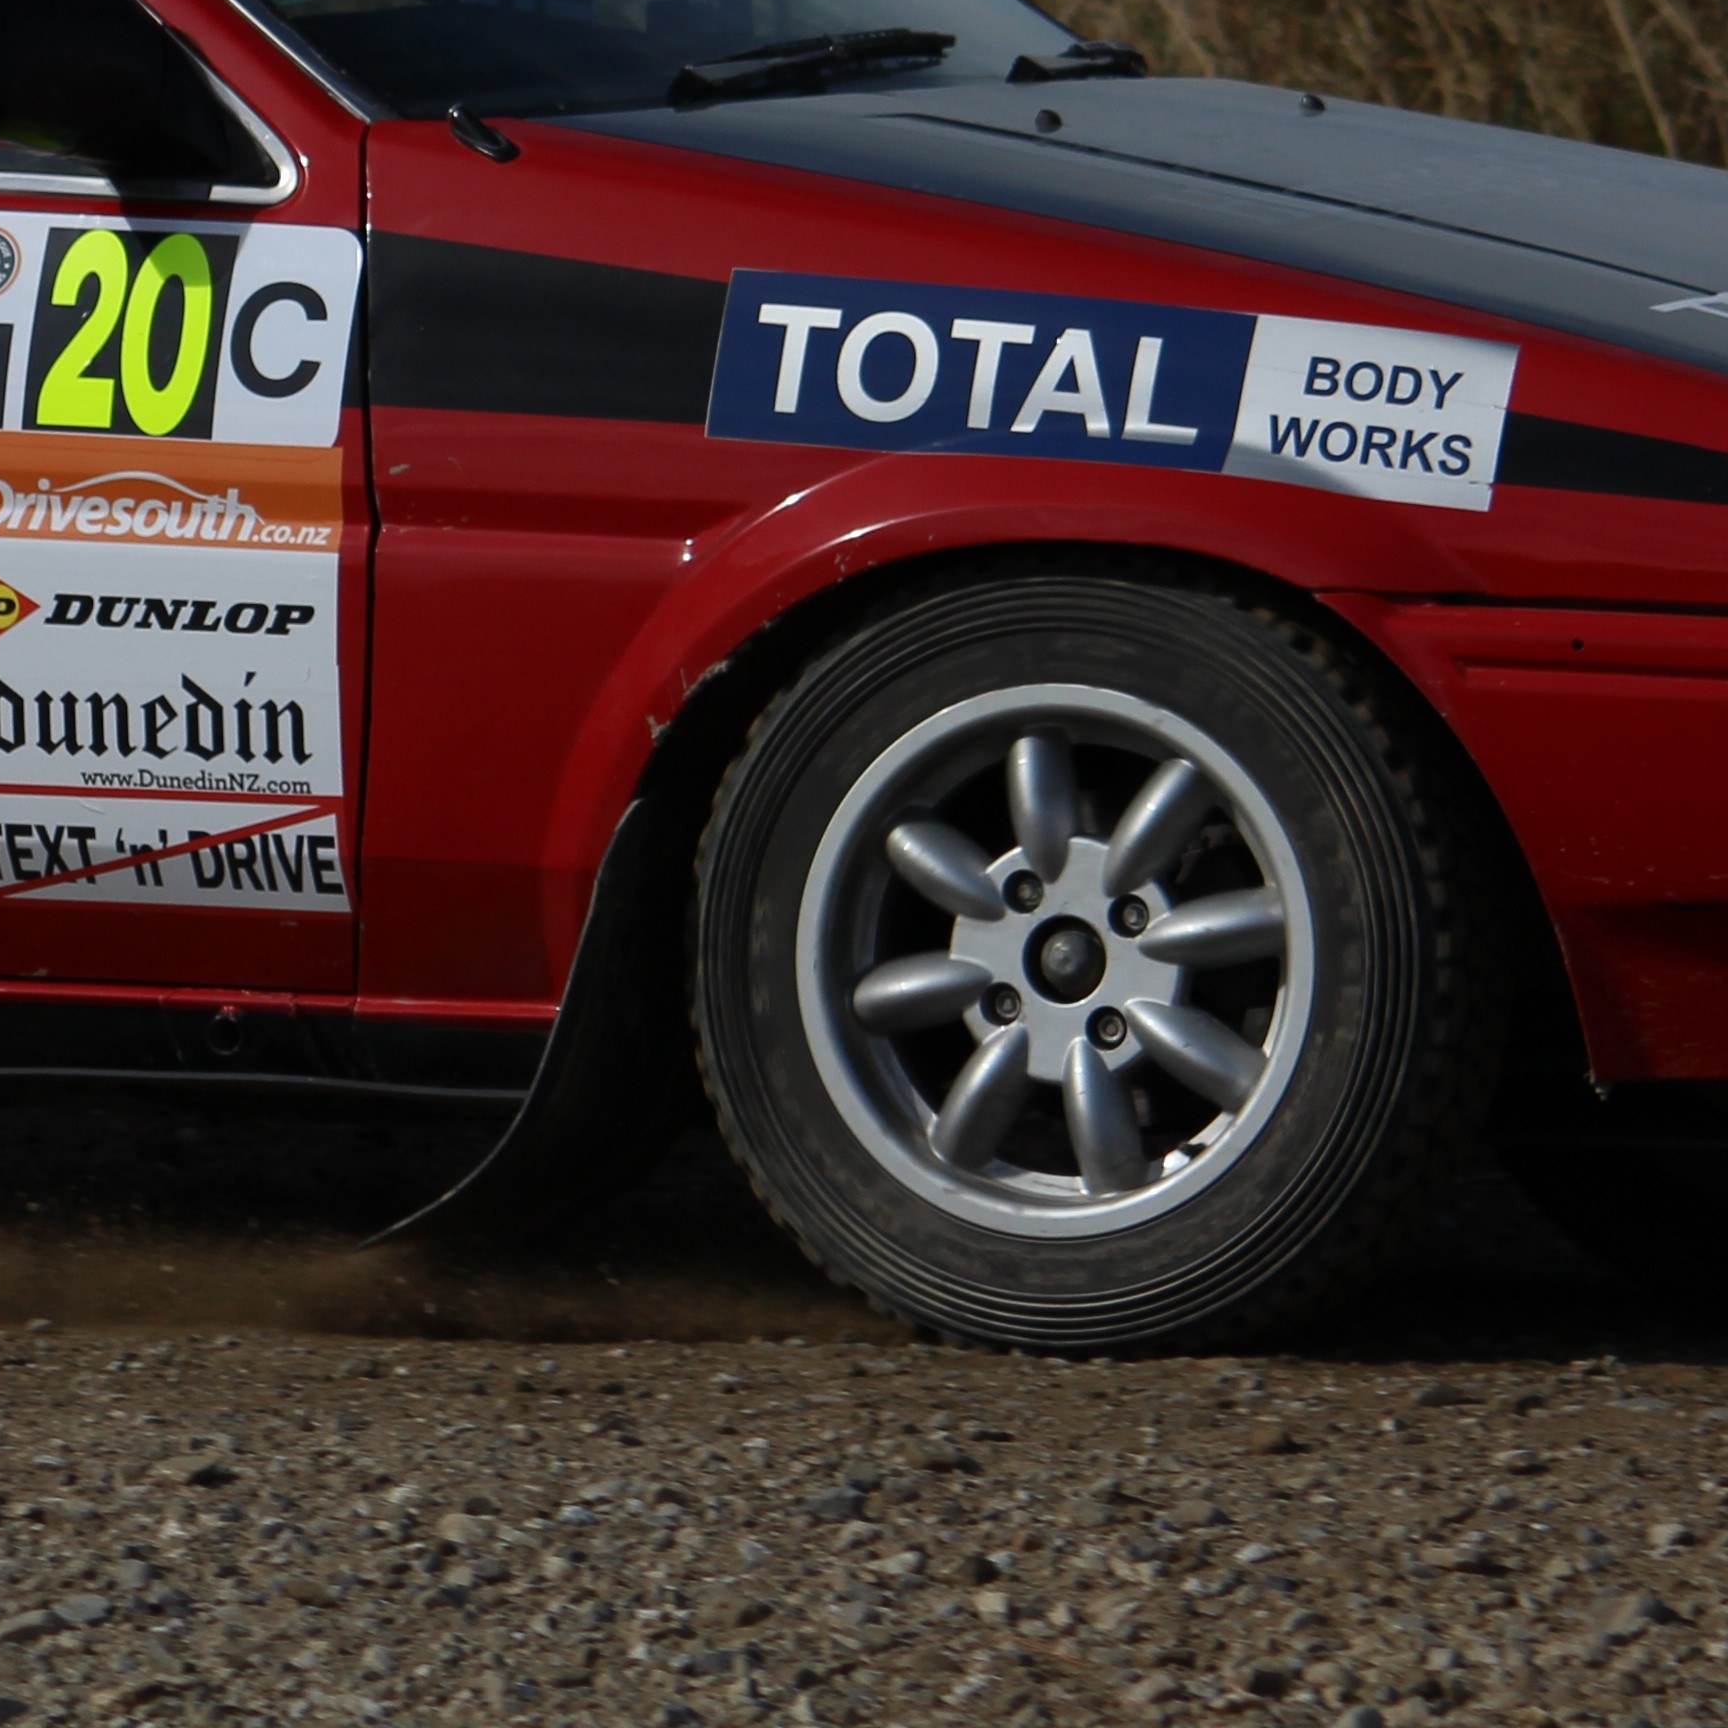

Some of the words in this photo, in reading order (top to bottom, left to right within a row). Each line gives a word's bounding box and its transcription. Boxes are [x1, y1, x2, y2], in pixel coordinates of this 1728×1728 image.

[37, 229, 213, 437] 20
[232, 280, 329, 399] C
[758, 303, 1199, 446] TOTAL
[1303, 356, 1465, 410] BODY
[1269, 415, 1473, 477] WORKS
[44, 593, 315, 636] DUNLOP
[80, 769, 313, 796] www.DunedinNZ.com
[186, 829, 345, 895] DRIVE
